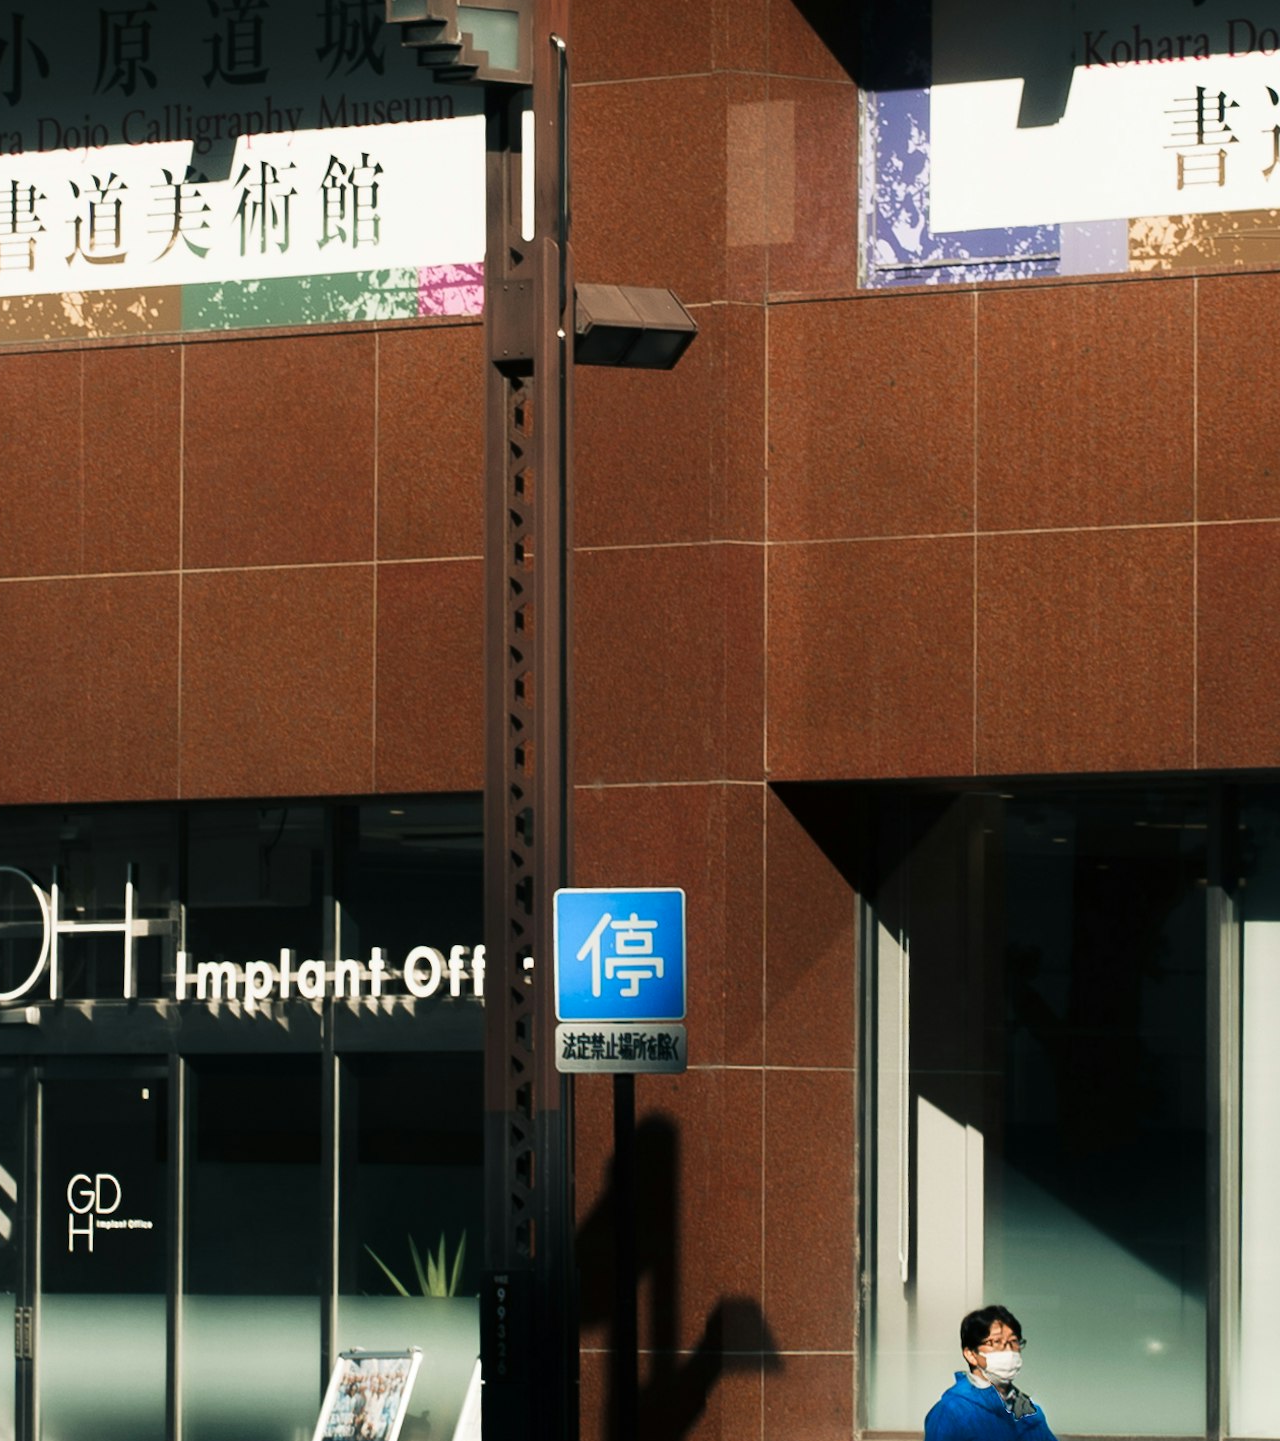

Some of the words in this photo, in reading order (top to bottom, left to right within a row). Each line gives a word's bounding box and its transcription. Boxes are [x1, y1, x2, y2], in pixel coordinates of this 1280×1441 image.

[1083, 23, 1210, 69] Kohara
[37, 115, 108, 163] Dojo
[122, 95, 303, 156] Calligraphy
[318, 94, 454, 130] Museum
[177, 947, 384, 1001] Implant
[576, 912, 664, 998] 停
[562, 1032, 680, 1062] 法定禁止場所を除く
